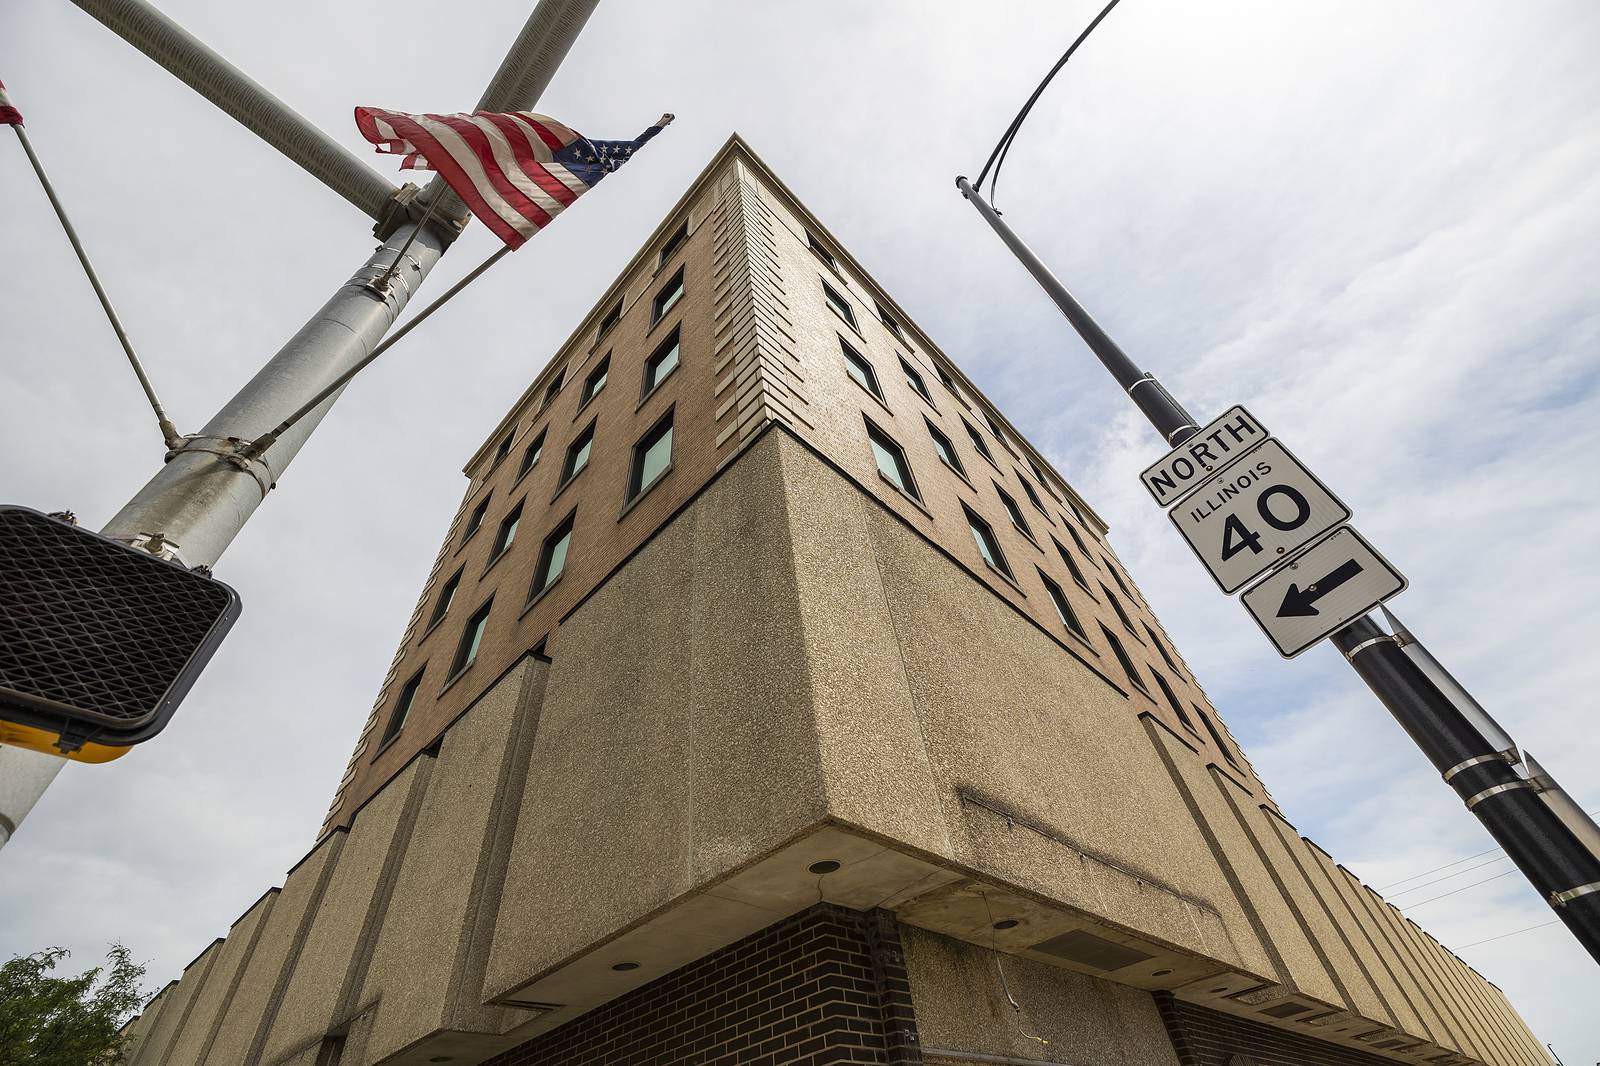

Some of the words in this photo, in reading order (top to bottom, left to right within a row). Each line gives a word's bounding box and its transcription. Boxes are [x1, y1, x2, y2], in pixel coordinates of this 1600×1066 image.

[1150, 415, 1256, 497] NORTH
[1190, 461, 1272, 523] ILLINOIS
[1221, 484, 1311, 562] 40
